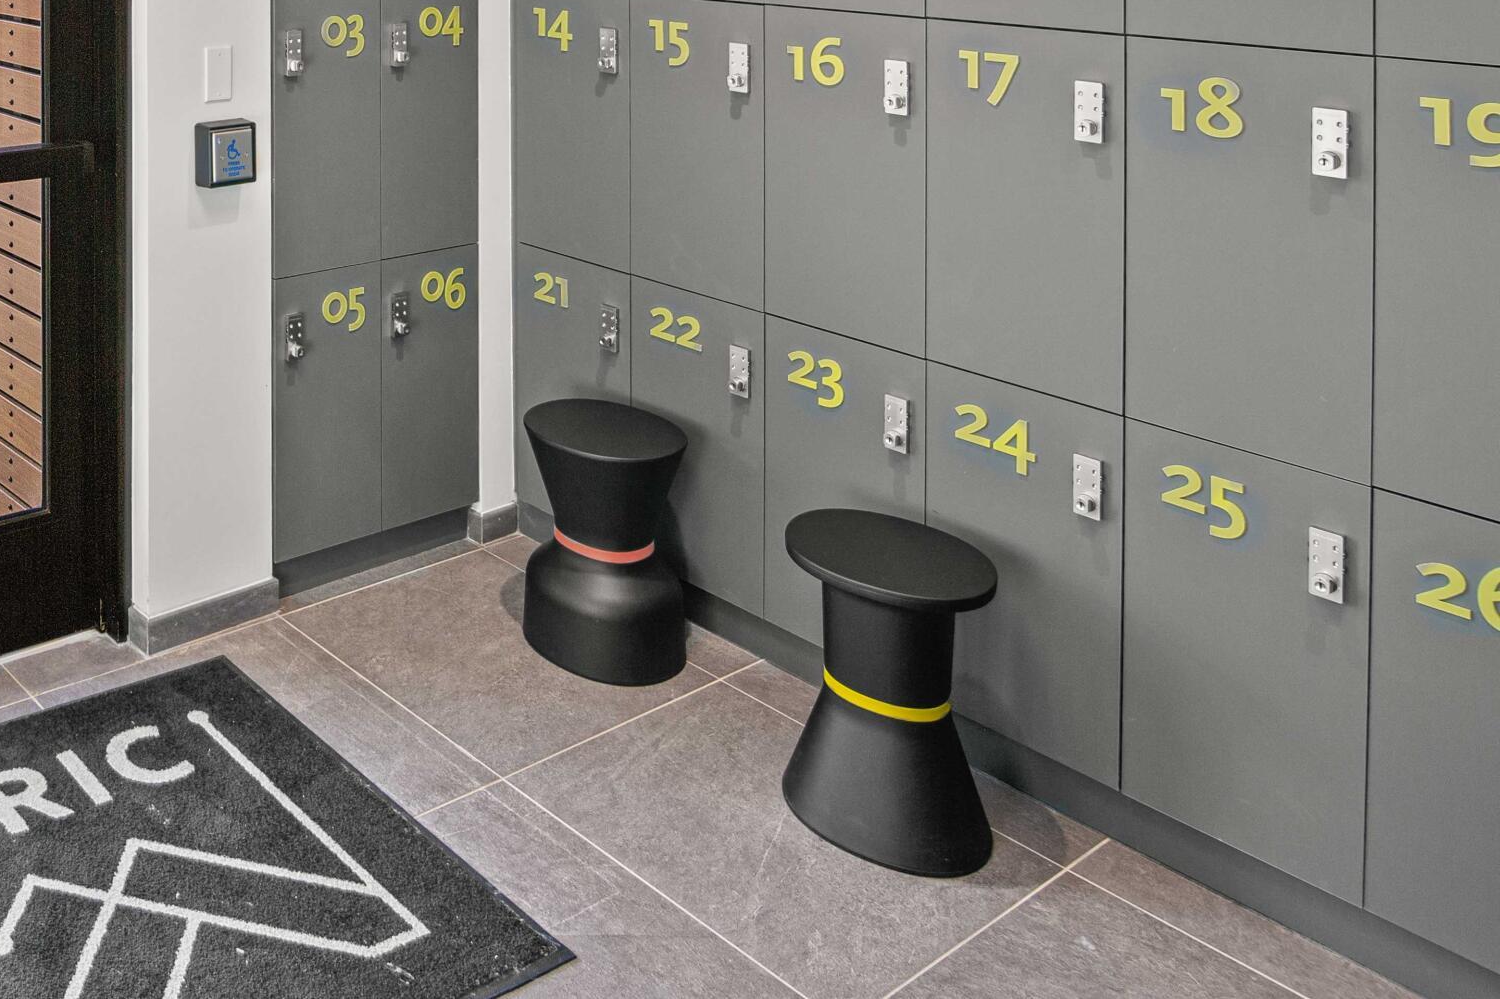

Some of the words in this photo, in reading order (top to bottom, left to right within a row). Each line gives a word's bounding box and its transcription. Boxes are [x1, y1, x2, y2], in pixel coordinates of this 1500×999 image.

[320, 14, 365, 57] 03
[419, 6, 464, 46] 04
[532, 7, 573, 52] 14
[647, 20, 689, 65] 15
[787, 38, 846, 87] 16
[960, 51, 1019, 105] 17
[1160, 76, 1244, 138] 18
[321, 286, 366, 332] 05
[420, 267, 466, 310] 06
[533, 271, 569, 308] 21
[650, 306, 702, 349] 22
[787, 349, 846, 409] 23
[955, 404, 1037, 475] 24
[1161, 465, 1248, 540] 25
